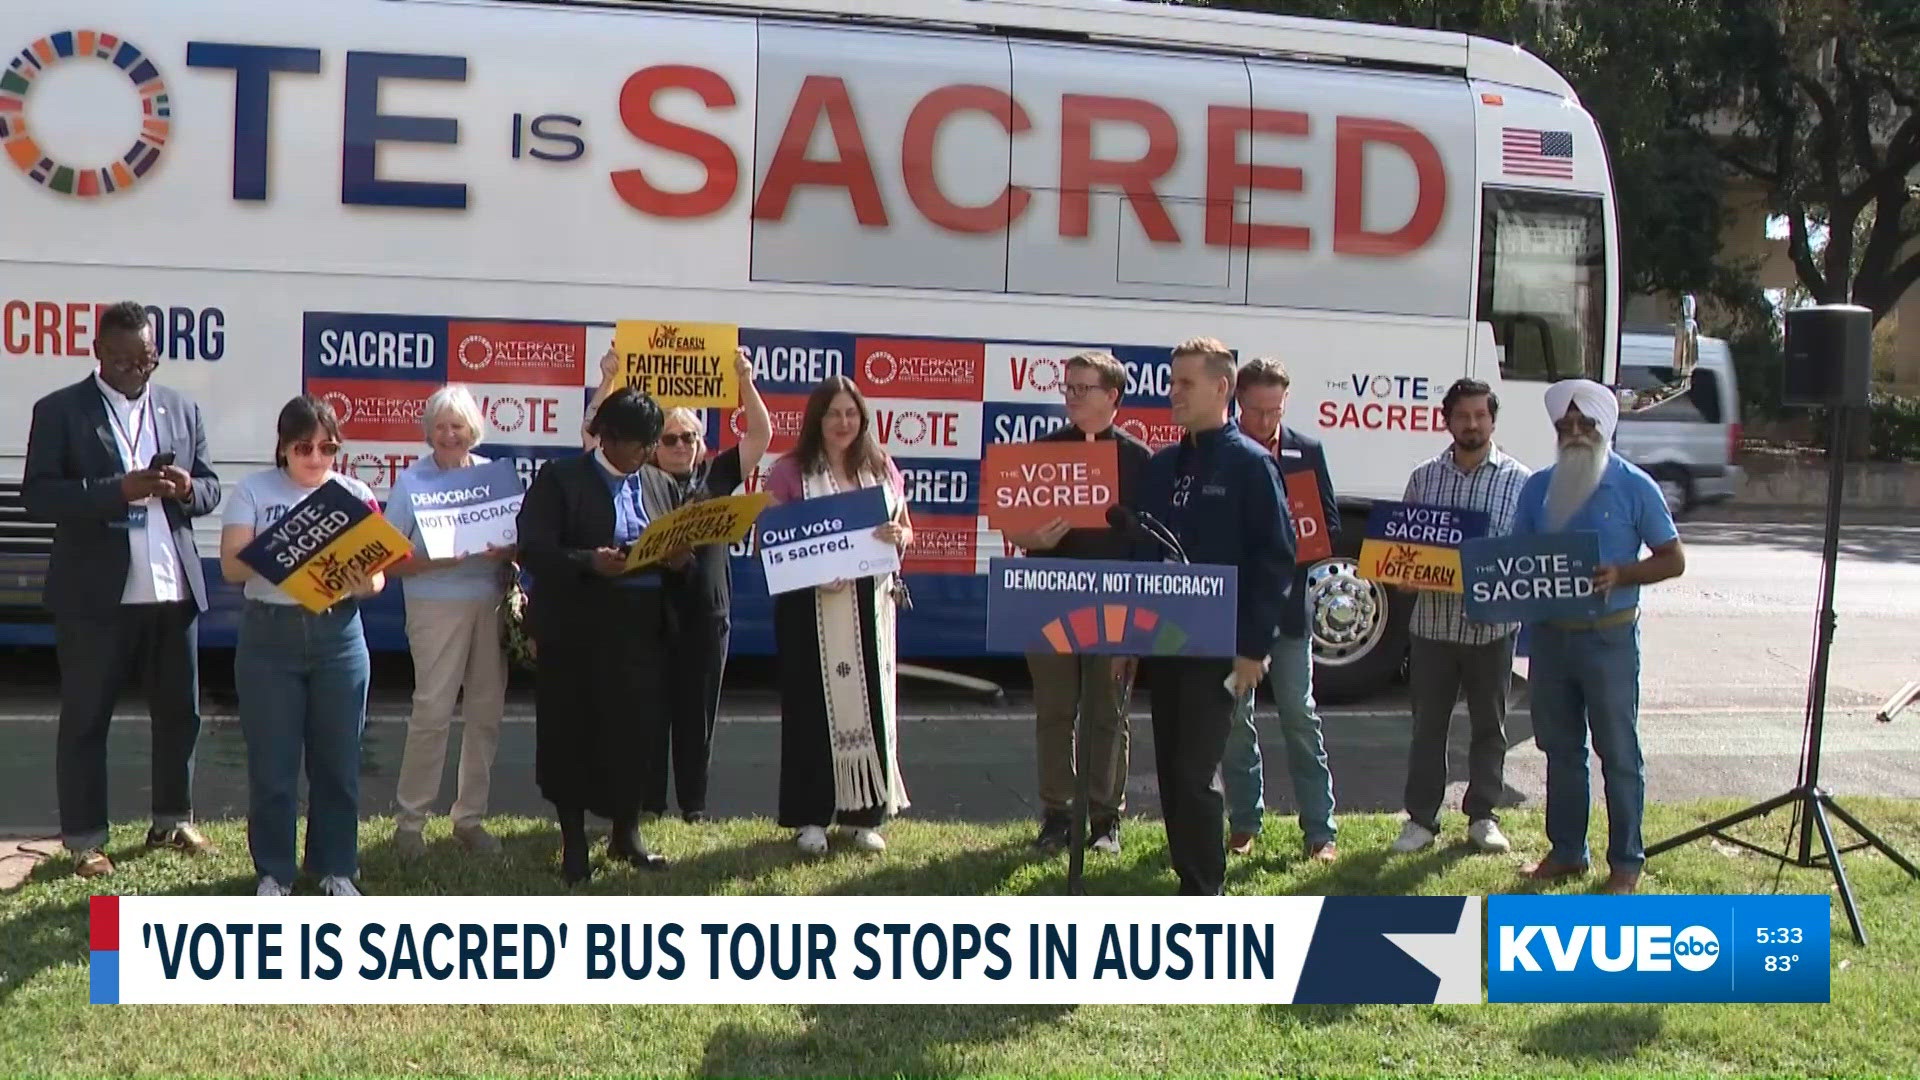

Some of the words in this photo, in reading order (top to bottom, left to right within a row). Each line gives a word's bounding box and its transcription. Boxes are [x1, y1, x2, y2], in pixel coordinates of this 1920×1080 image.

[512, 113, 585, 162] IS
[610, 64, 1447, 257] SACRED
[320, 328, 435, 369] SACRED
[494, 341, 576, 352] INTERFAITH
[648, 327, 674, 350] VOTE
[676, 336, 705, 351] EARLY
[494, 350, 576, 362] ALLIANCE
[626, 353, 724, 378] FAITHFULLY,
[899, 357, 975, 370] INTERFAITH
[899, 365, 974, 376] ALLIANCE
[626, 376, 652, 396] WE
[657, 376, 727, 398] DISSENT.
[1327, 381, 1348, 390] THE
[1351, 373, 1429, 400] VOTE
[354, 397, 428, 409] INTERFAIT
[354, 406, 425, 418] ALLIANC
[877, 410, 958, 447] VOTE
[1020, 462, 1088, 483] VOTE
[410, 485, 491, 507] DEMOCRACY
[901, 468, 968, 503] CRED
[996, 485, 1111, 508] SACRED
[272, 504, 322, 542] VOTE
[419, 514, 443, 529] NOT
[1406, 507, 1452, 526] VOTE
[276, 510, 350, 568] SACRED
[762, 526, 800, 545] Our
[801, 518, 844, 537] vote
[1384, 521, 1464, 545] SACRED
[768, 549, 784, 565] is
[788, 535, 855, 562] sacred.
[1375, 547, 1413, 578] VOTE
[1413, 564, 1456, 587] EARLY
[1497, 554, 1570, 577] VOTE
[1004, 568, 1098, 593] DEMOCRACY,
[1102, 572, 1131, 593] NOT
[1135, 573, 1224, 597] THEOCRACY!
[1472, 576, 1594, 602] SACRED
